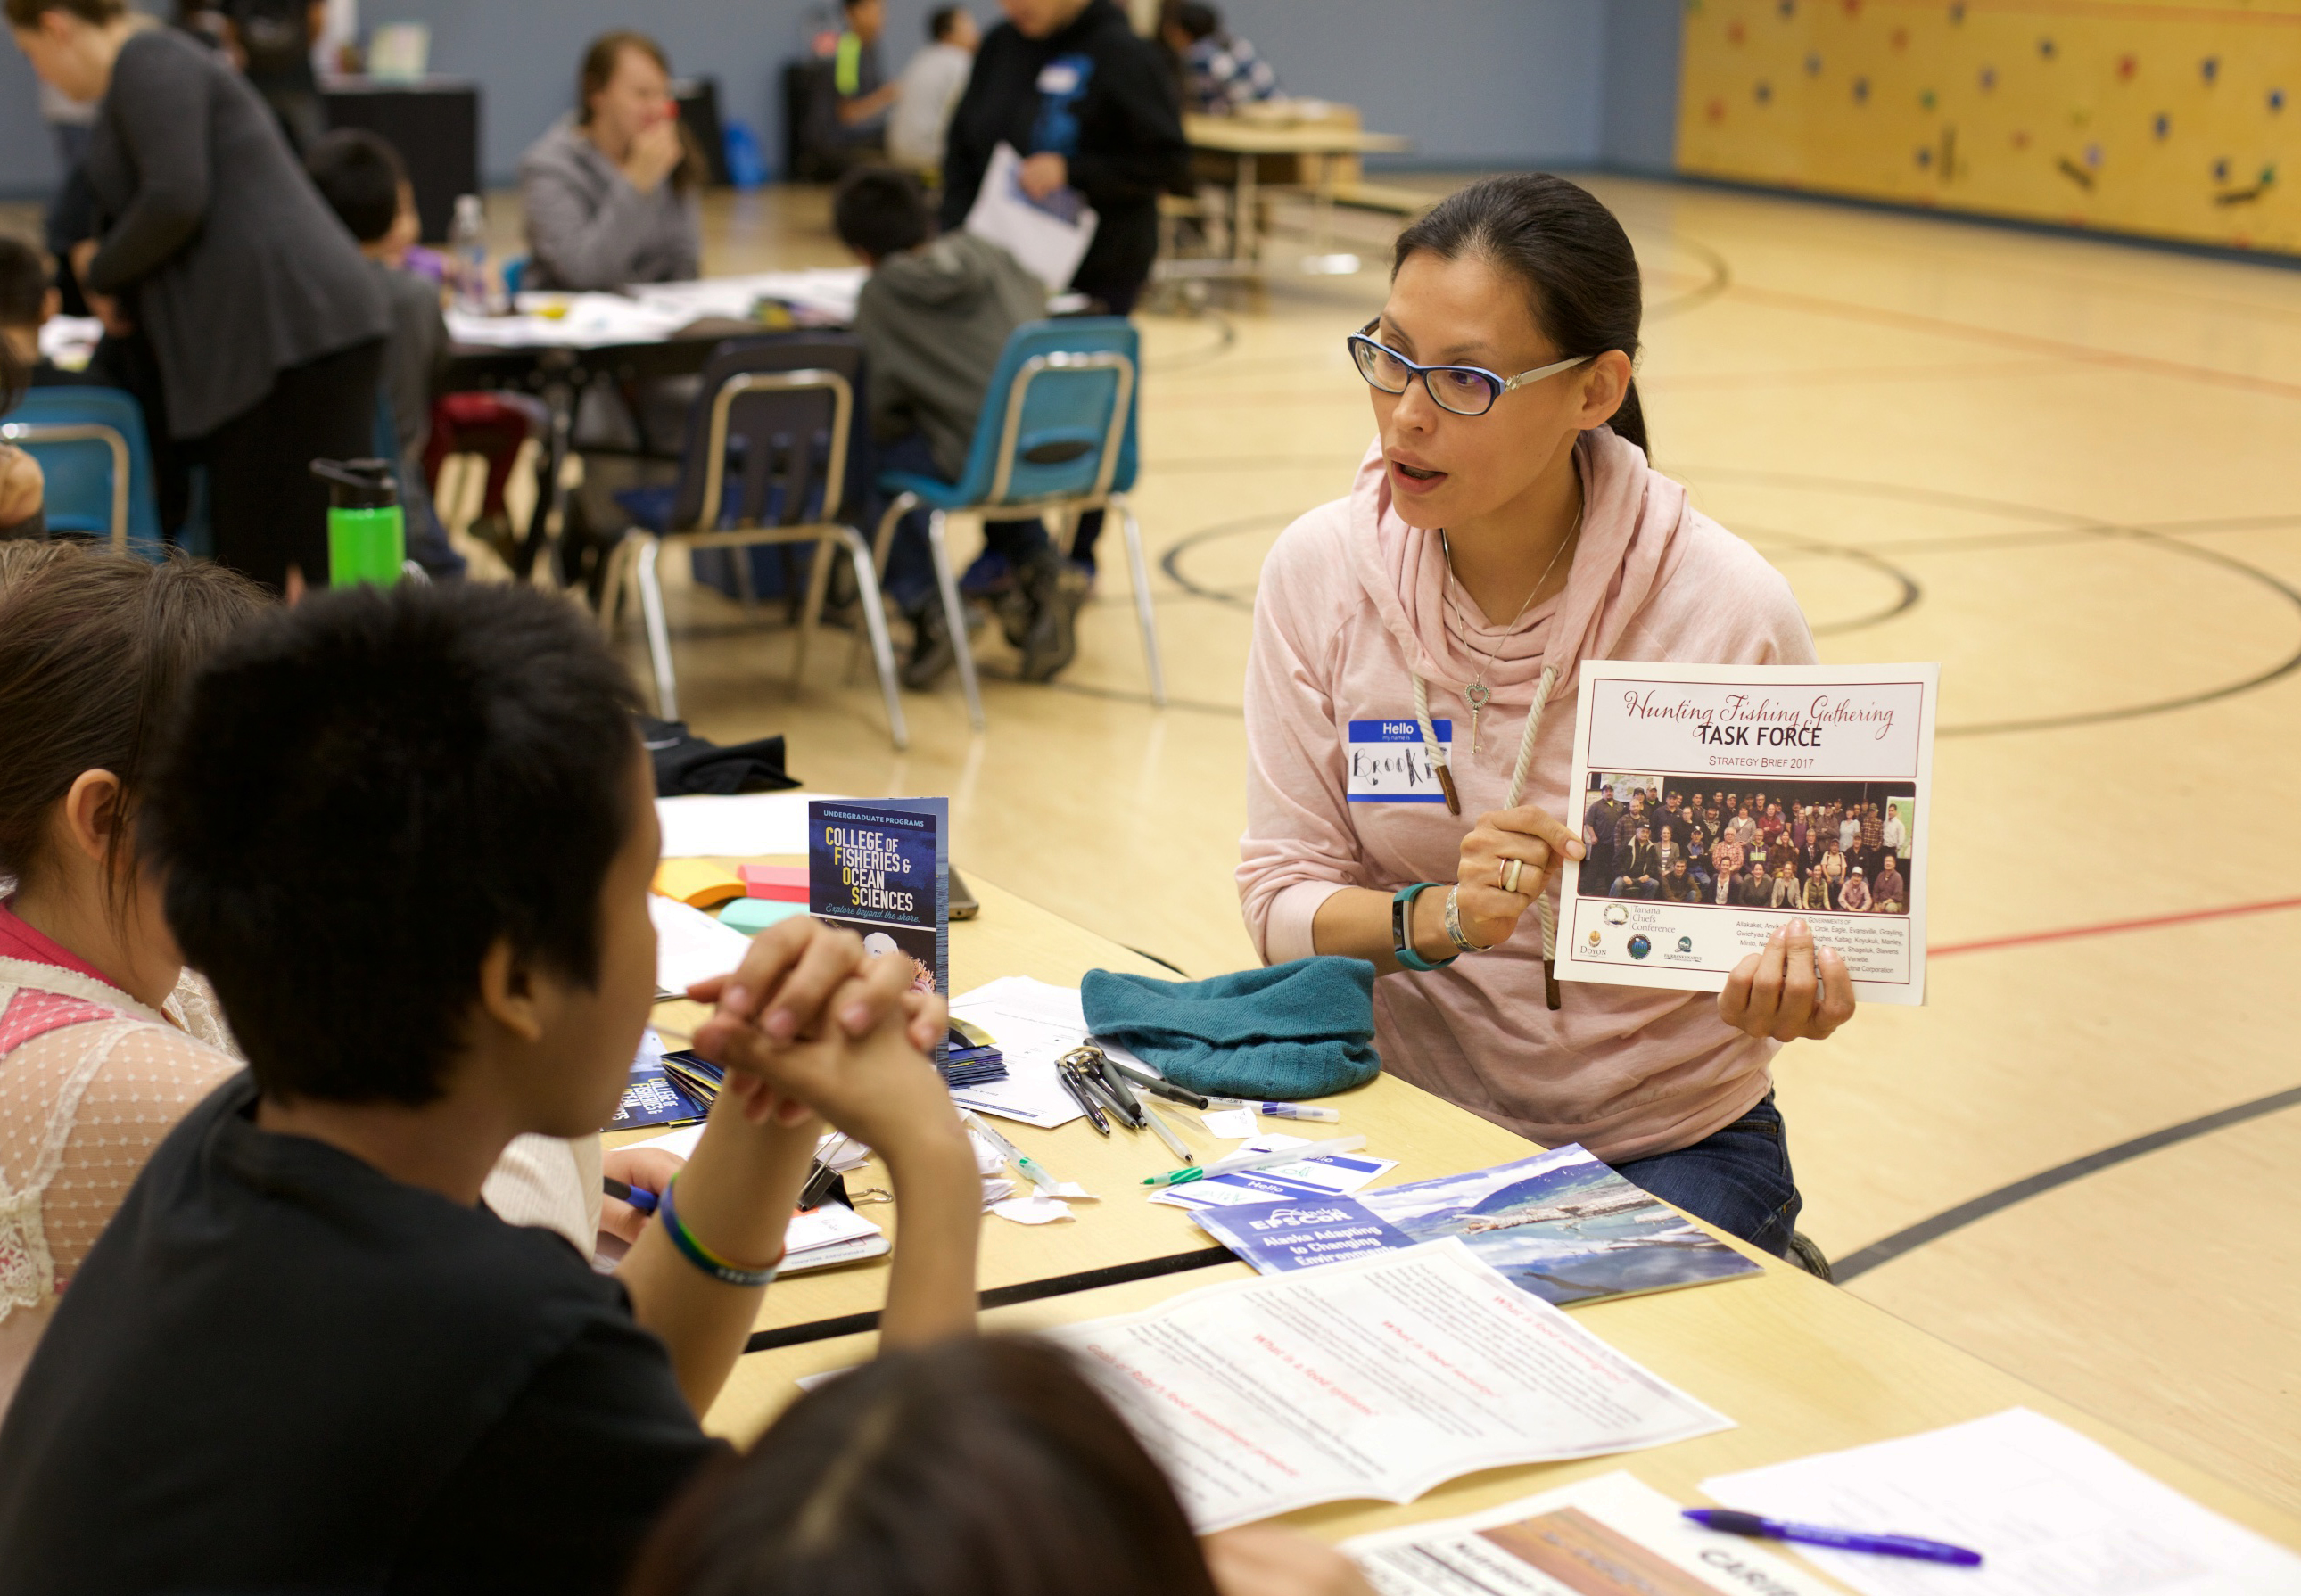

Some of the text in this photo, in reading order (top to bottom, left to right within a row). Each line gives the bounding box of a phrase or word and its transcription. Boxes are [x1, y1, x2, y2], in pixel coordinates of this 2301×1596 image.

[1624, 690, 1894, 741] Hunting Fishing Gathering
[1382, 723, 1414, 735] Hello
[1697, 725, 1823, 747] TASK FORCE
[1709, 756, 1814, 769] STRATEGY BRIEF 2017
[823, 810, 925, 827] UNDERGRADUATE PROGRAMS
[825, 827, 899, 853] COLLEGE OF
[834, 846, 911, 874] FISHERIES &
[843, 867, 885, 890] OCEAN
[851, 887, 913, 912] SCIENCES
[825, 903, 920, 924] Explore beyond the shore.
[1632, 914, 1656, 923] Chiefs
[1633, 905, 1661, 914] Tanana
[1631, 923, 1676, 934] Conference
[1736, 921, 1762, 929] Allakaket,
[1861, 966, 1893, 974] Corporation
[631, 1082, 664, 1111] FISHERIES
[647, 1077, 679, 1101] COLLEGE
[1248, 1181, 1284, 1193] Hello
[1262, 1226, 1382, 1246] Alaska Adapting
[1289, 1237, 1381, 1255] to Changing
